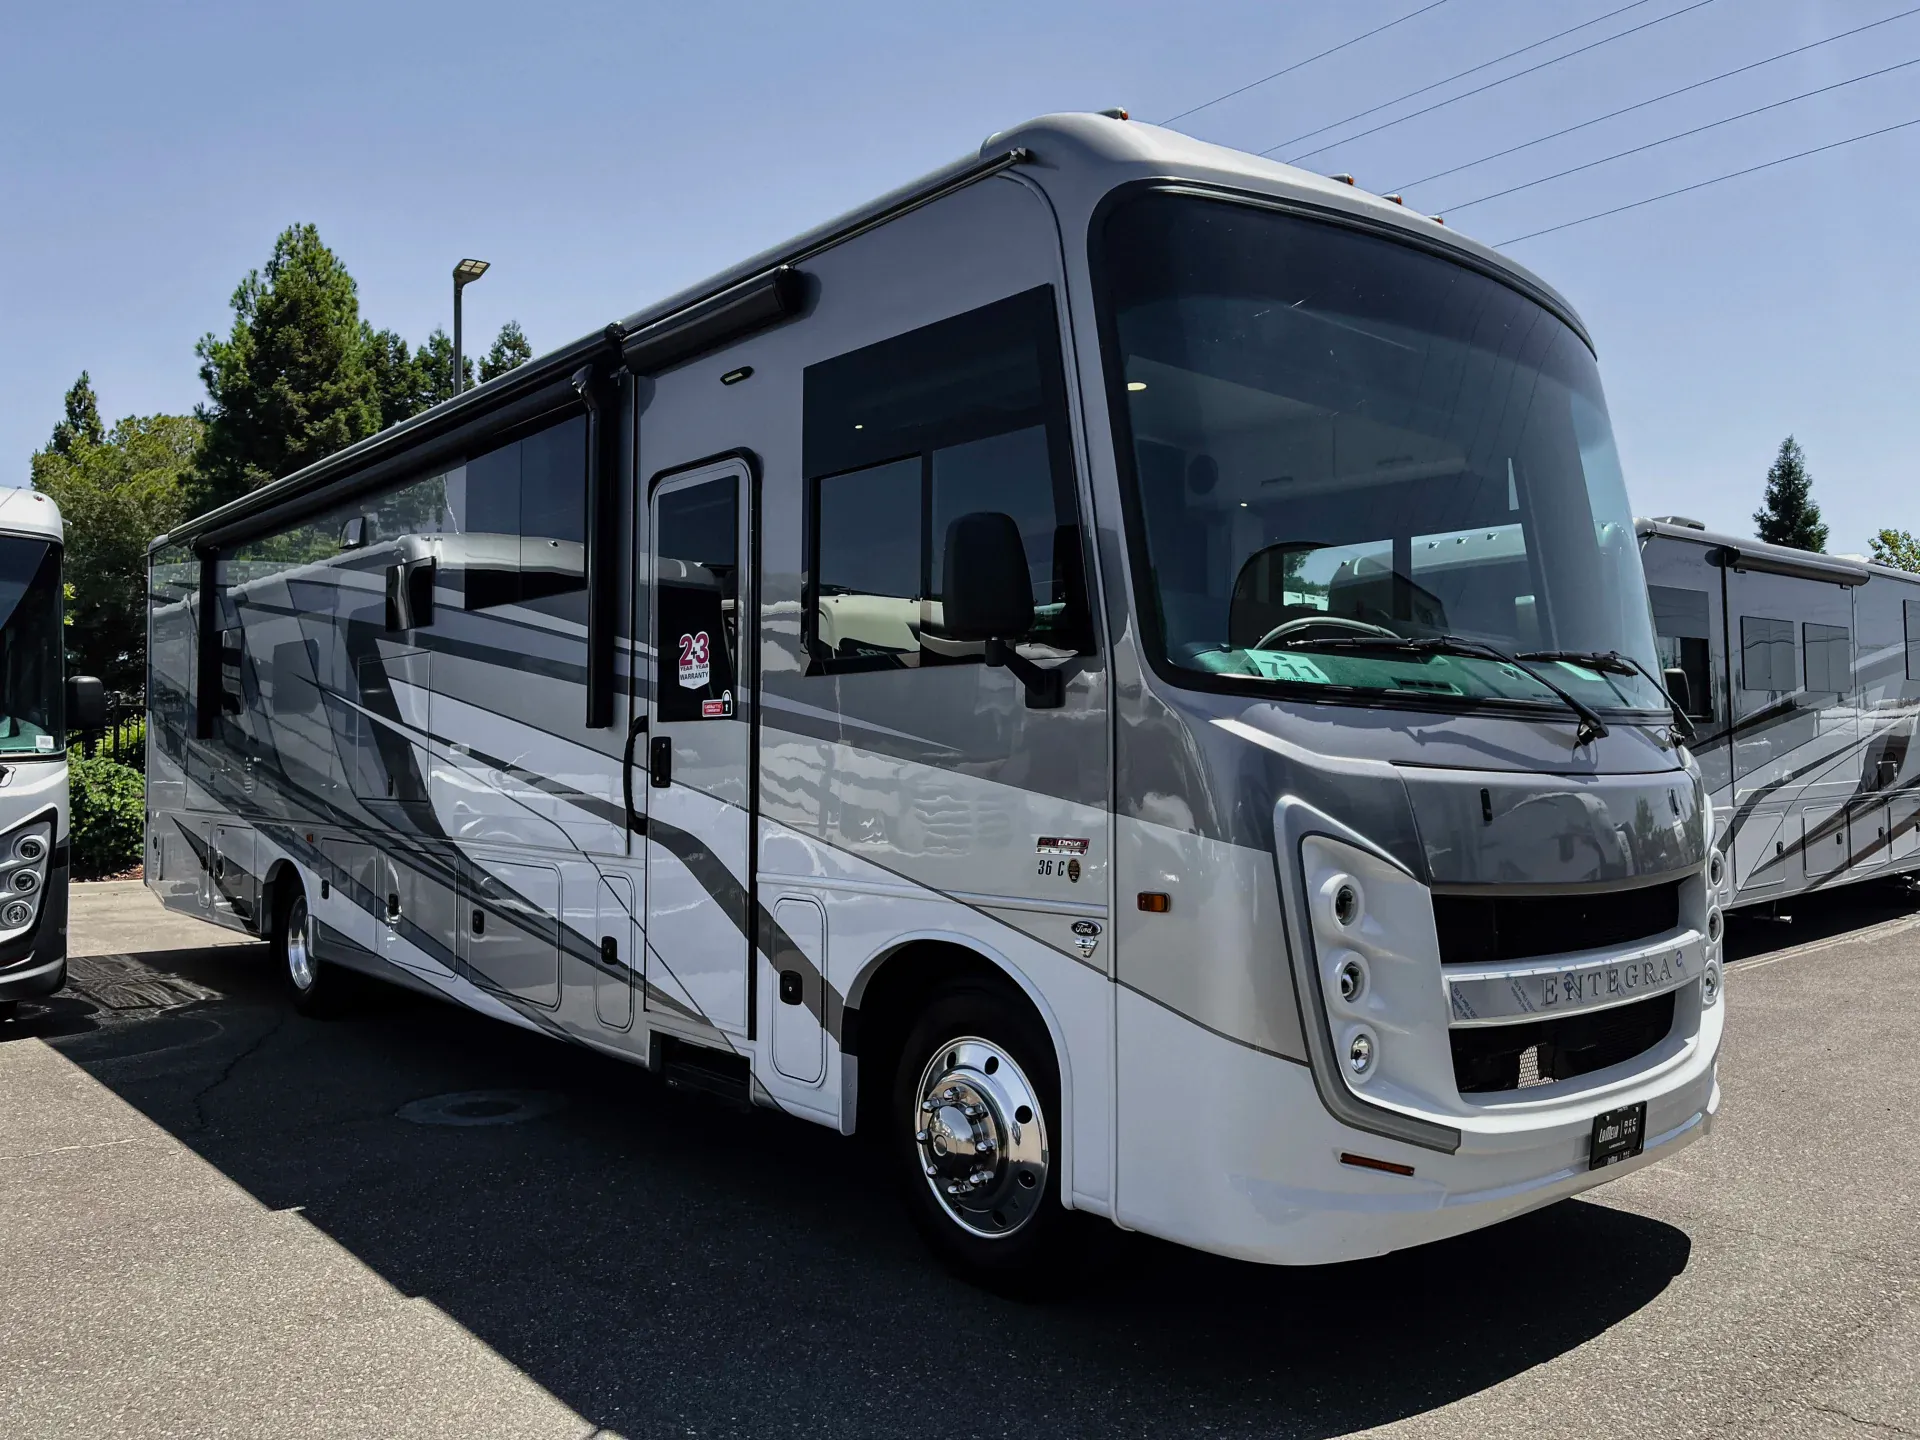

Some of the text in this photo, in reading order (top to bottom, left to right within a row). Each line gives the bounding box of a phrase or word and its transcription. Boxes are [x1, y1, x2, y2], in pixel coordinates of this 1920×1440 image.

[680, 671, 709, 680] WARRANTY
[1037, 859, 1053, 876] 36
[1057, 860, 1065, 877] C
[1075, 922, 1093, 934] Ford
[1540, 957, 1673, 1007] ENTEGRA
